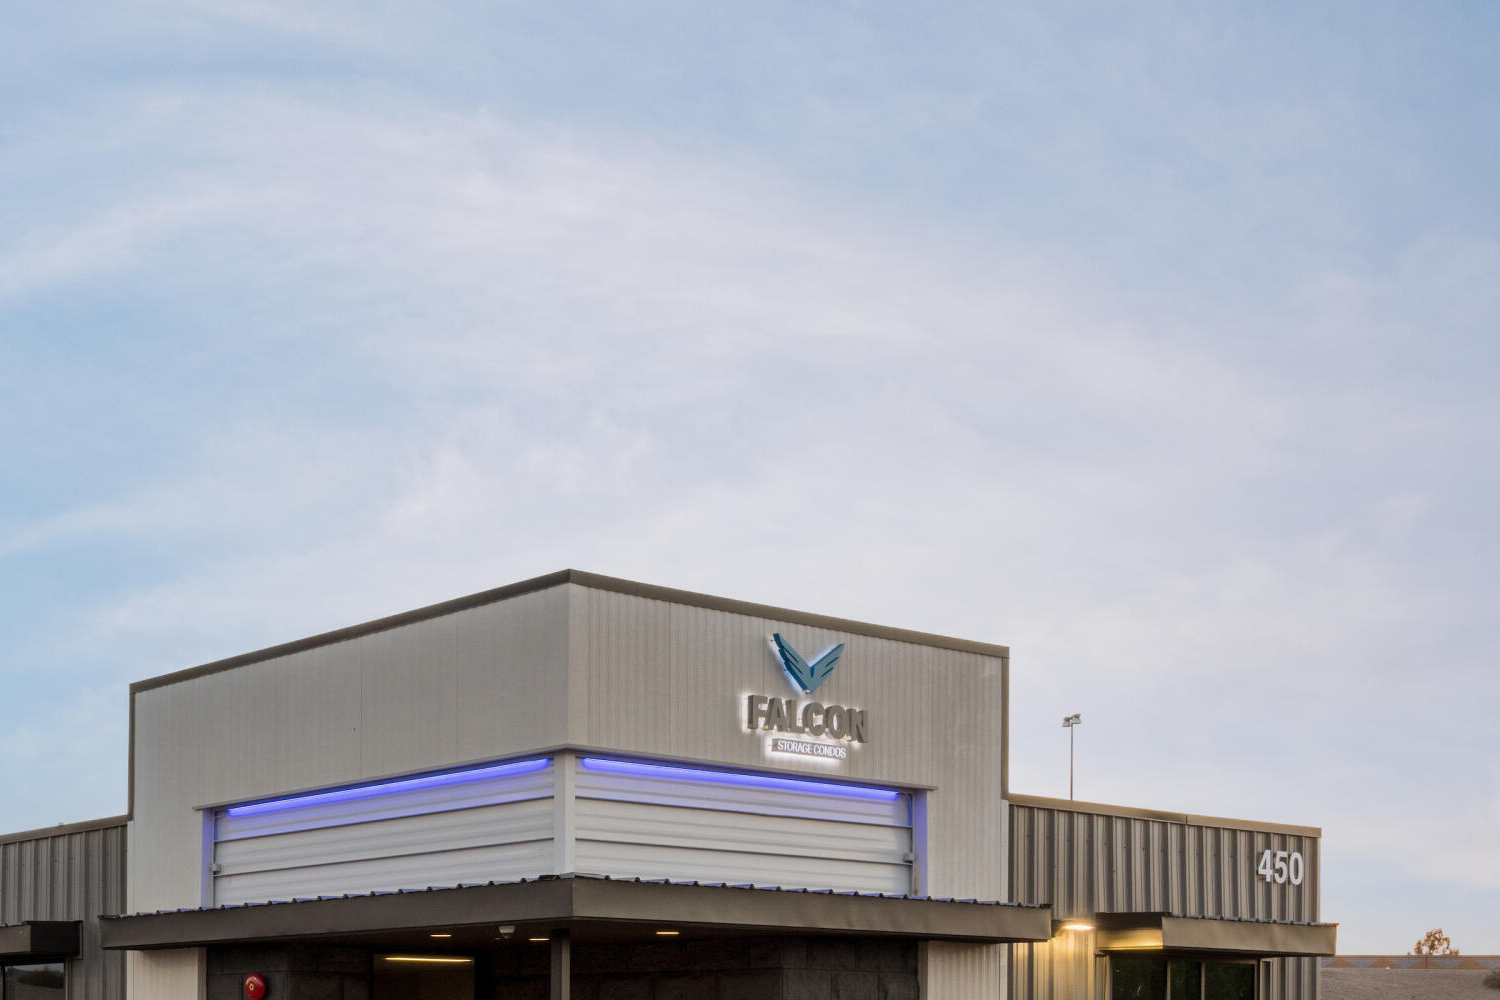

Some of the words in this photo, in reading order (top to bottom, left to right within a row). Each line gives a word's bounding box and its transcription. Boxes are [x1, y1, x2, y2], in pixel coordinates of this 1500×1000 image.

[747, 694, 869, 743] FALCON
[778, 740, 812, 754] STORAGE
[813, 744, 846, 758] CONDOS
[1258, 849, 1304, 886] 450
